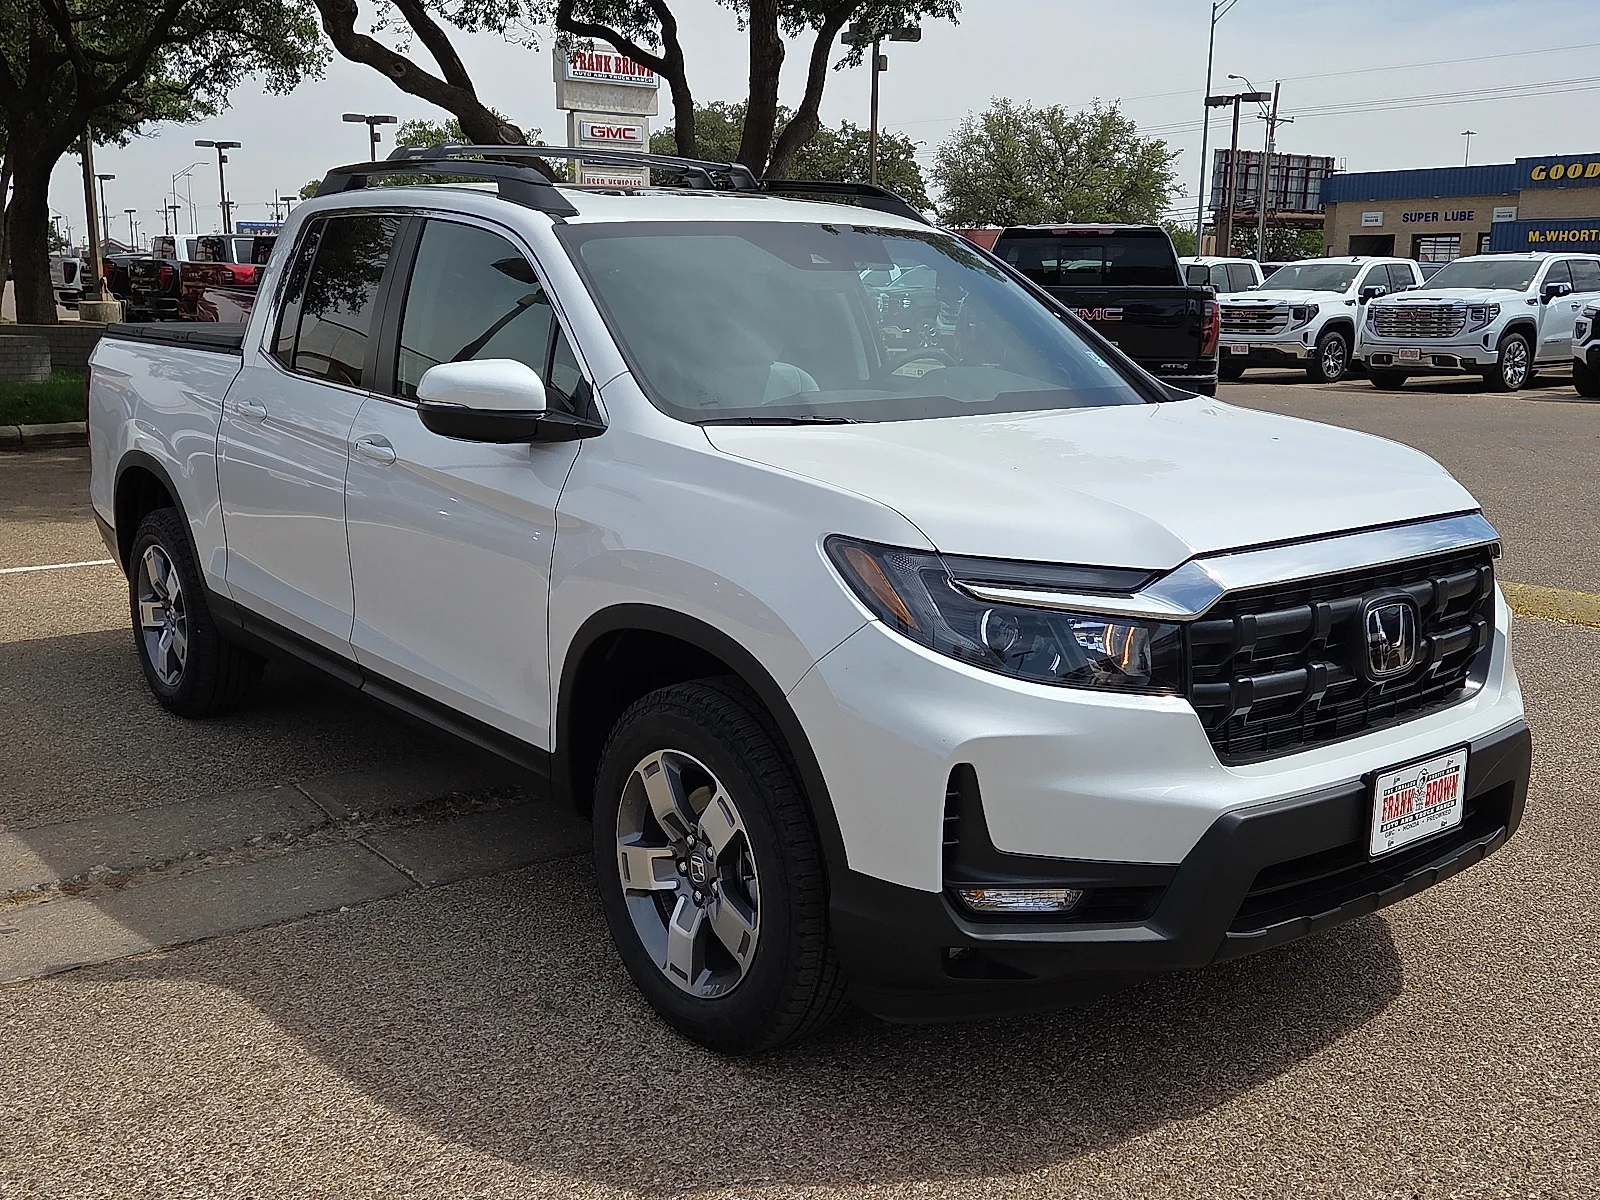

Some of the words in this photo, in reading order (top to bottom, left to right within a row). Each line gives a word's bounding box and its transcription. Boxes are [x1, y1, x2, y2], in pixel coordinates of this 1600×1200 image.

[573, 52, 611, 73] FRANK
[590, 126, 637, 140] GMC
[1401, 211, 1440, 223] SUPER
[1443, 210, 1475, 222] LUBE
[1528, 229, 1600, 243] McWHORT
[1381, 788, 1415, 823] FRANK
[1425, 774, 1459, 807] BROWN
[1382, 821, 1399, 832] AUTO
[1400, 816, 1414, 826] AND
[1414, 808, 1435, 819] TRUCK
[1402, 821, 1420, 832] HONDA
